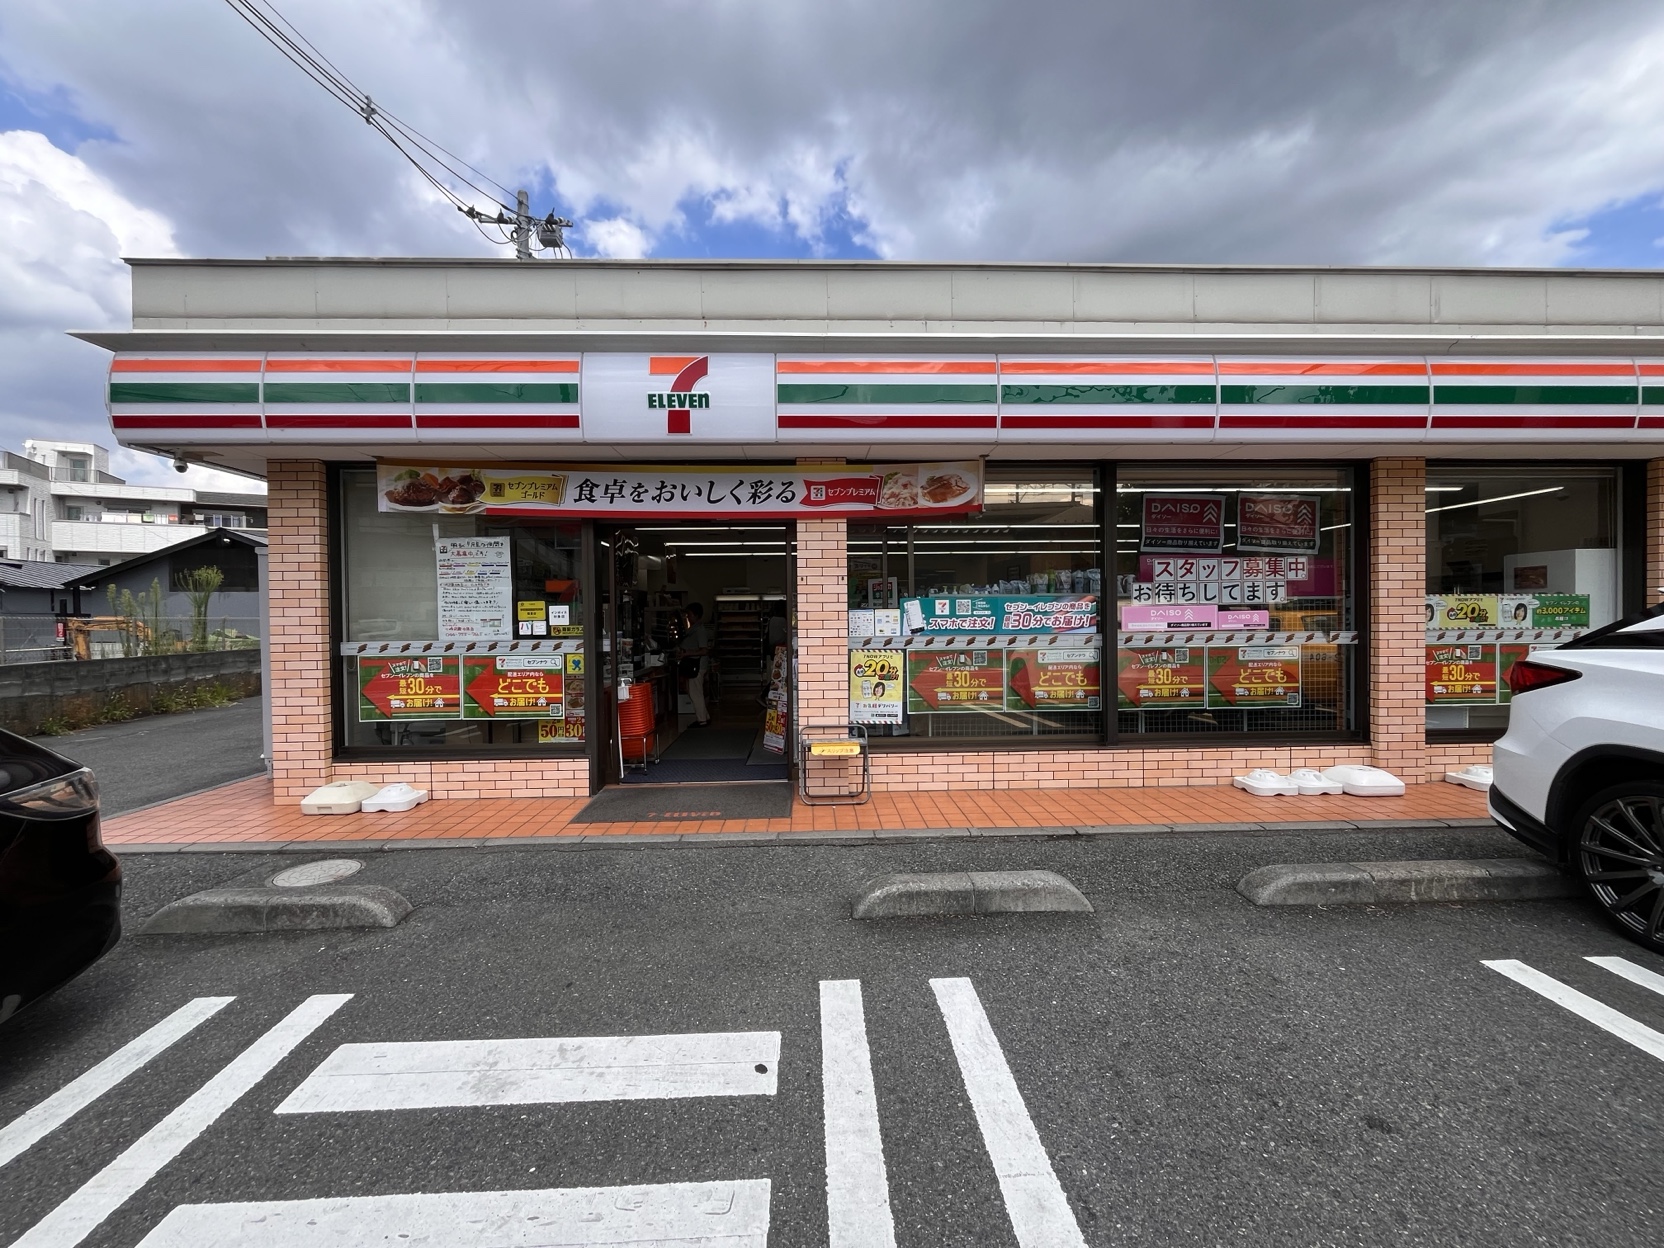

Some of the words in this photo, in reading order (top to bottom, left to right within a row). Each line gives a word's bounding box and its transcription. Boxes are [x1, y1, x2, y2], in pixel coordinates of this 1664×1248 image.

[508, 481, 558, 491] セブンプレミアム
[520, 490, 546, 500] ゴールド
[573, 478, 797, 506] 食卓をおいしく彩る
[828, 487, 876, 497] セブンプレミアム
[1152, 503, 1200, 513] DAISO
[1245, 502, 1293, 514] DAISO
[1150, 609, 1182, 617] DAISO
[1039, 670, 1087, 686] どこでも
[1240, 667, 1287, 683] どこでも
[498, 678, 549, 693] どこでも
